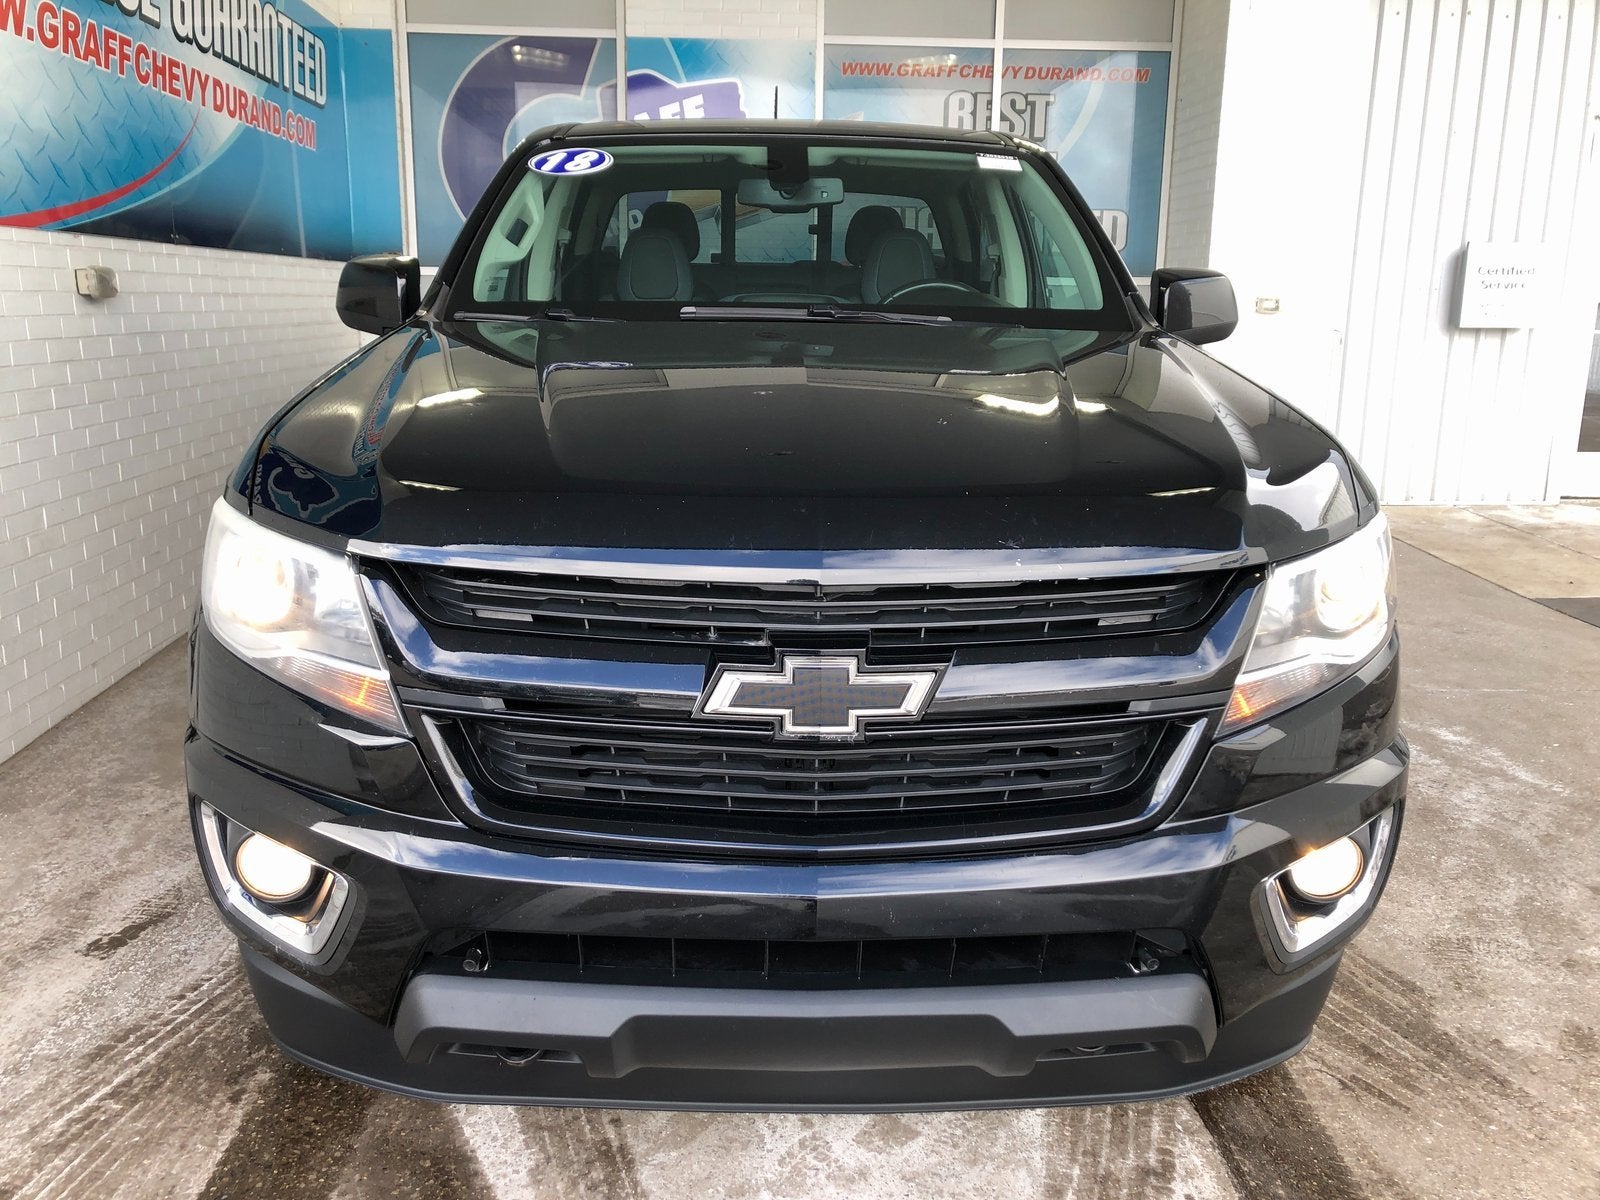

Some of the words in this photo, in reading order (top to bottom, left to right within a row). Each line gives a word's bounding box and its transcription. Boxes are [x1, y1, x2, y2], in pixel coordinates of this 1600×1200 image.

[540, 151, 600, 171] 18
[1477, 266, 1536, 276] Certified
[1481, 280, 1526, 289] Service
